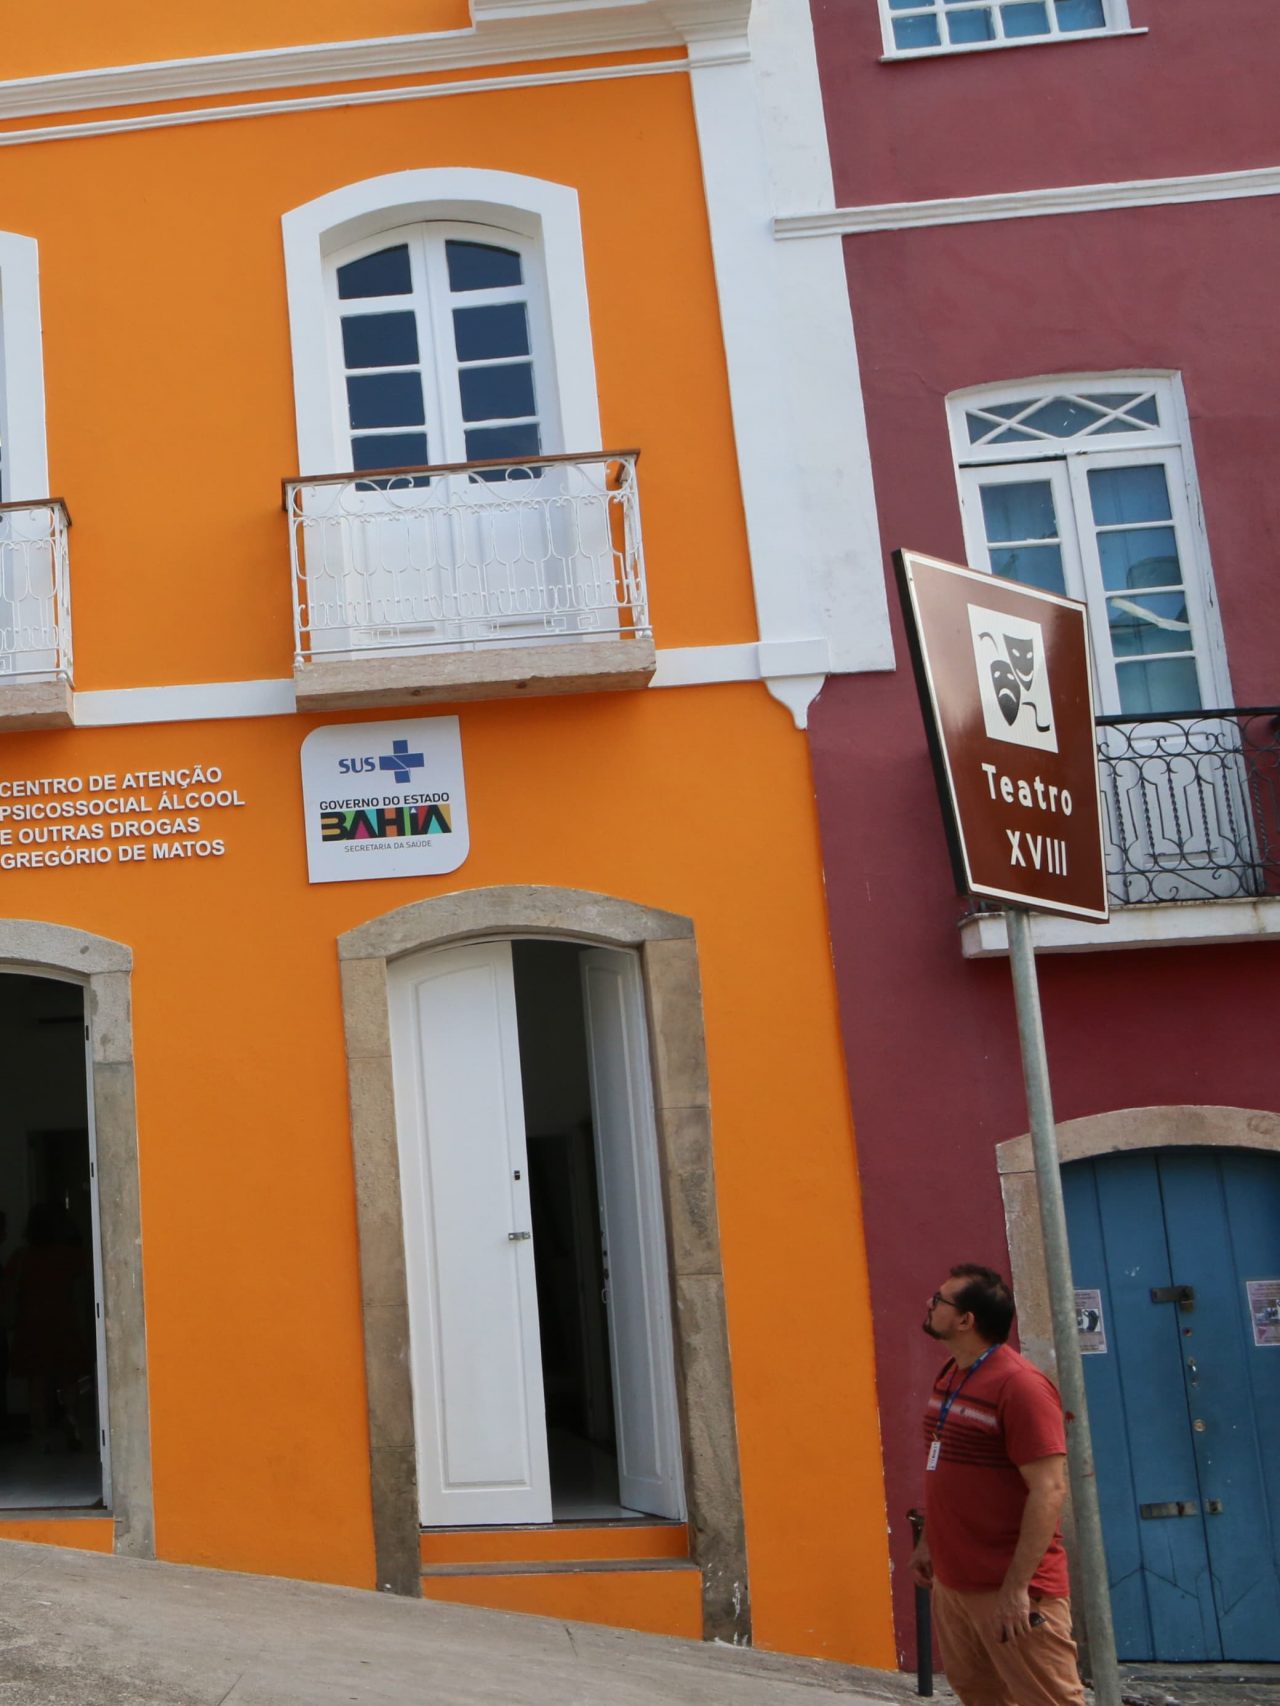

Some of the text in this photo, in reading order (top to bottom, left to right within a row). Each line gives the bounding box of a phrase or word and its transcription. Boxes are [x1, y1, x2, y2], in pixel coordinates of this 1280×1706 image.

[89, 774, 117, 792] DE
[122, 765, 222, 790] ATENÇÃO
[338, 757, 376, 774] SUS
[158, 790, 246, 811] ÁLCOOL
[320, 792, 449, 810] GOVERNO DO ESTADO
[981, 763, 1072, 816] Teatro
[0, 817, 200, 845] E OUTRAS DROGAS
[320, 804, 452, 842] BAHIA
[0, 839, 225, 869] GREGÓRIO DE MATOS
[344, 843, 392, 853] SECRETARIA
[394, 842, 405, 850] DA
[1006, 829, 1067, 876] XVIII
